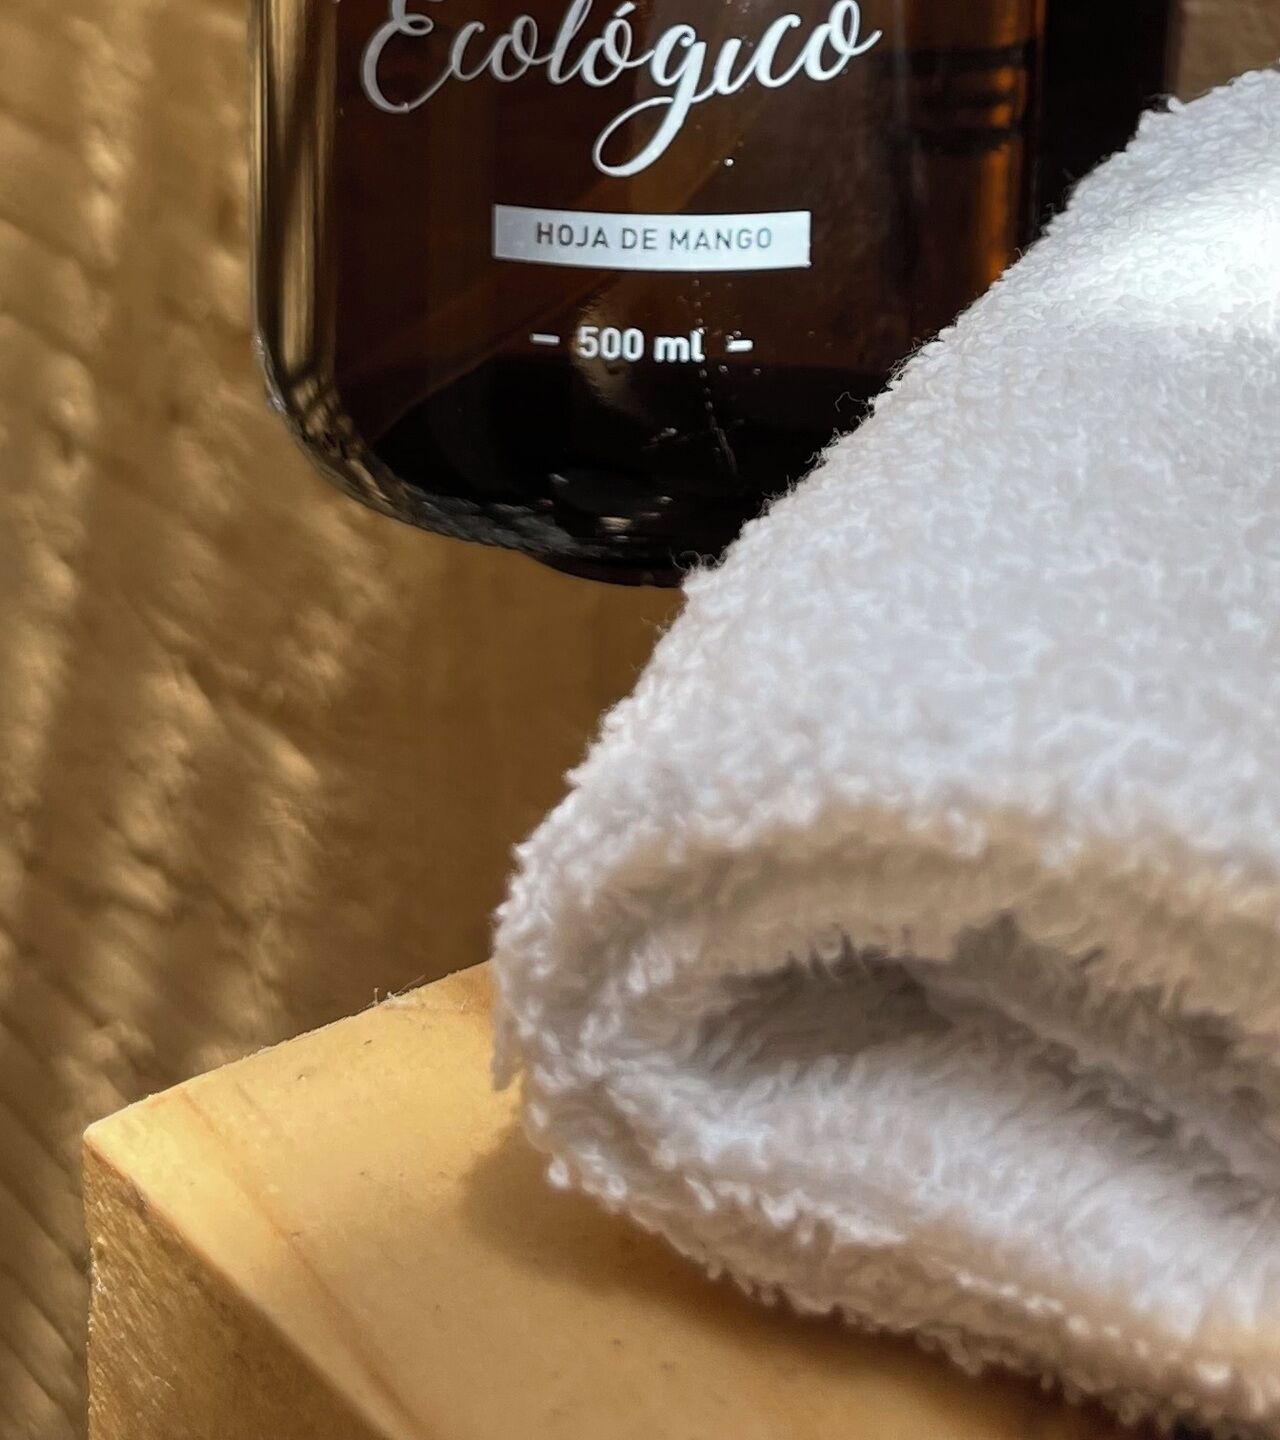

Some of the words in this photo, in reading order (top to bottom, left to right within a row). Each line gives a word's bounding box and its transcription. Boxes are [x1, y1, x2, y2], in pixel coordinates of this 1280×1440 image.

[535, 221, 610, 249] HOJA
[620, 226, 659, 251] DE
[669, 227, 773, 251] MANGO
[578, 326, 646, 360] 500
[654, 327, 706, 362] ml
